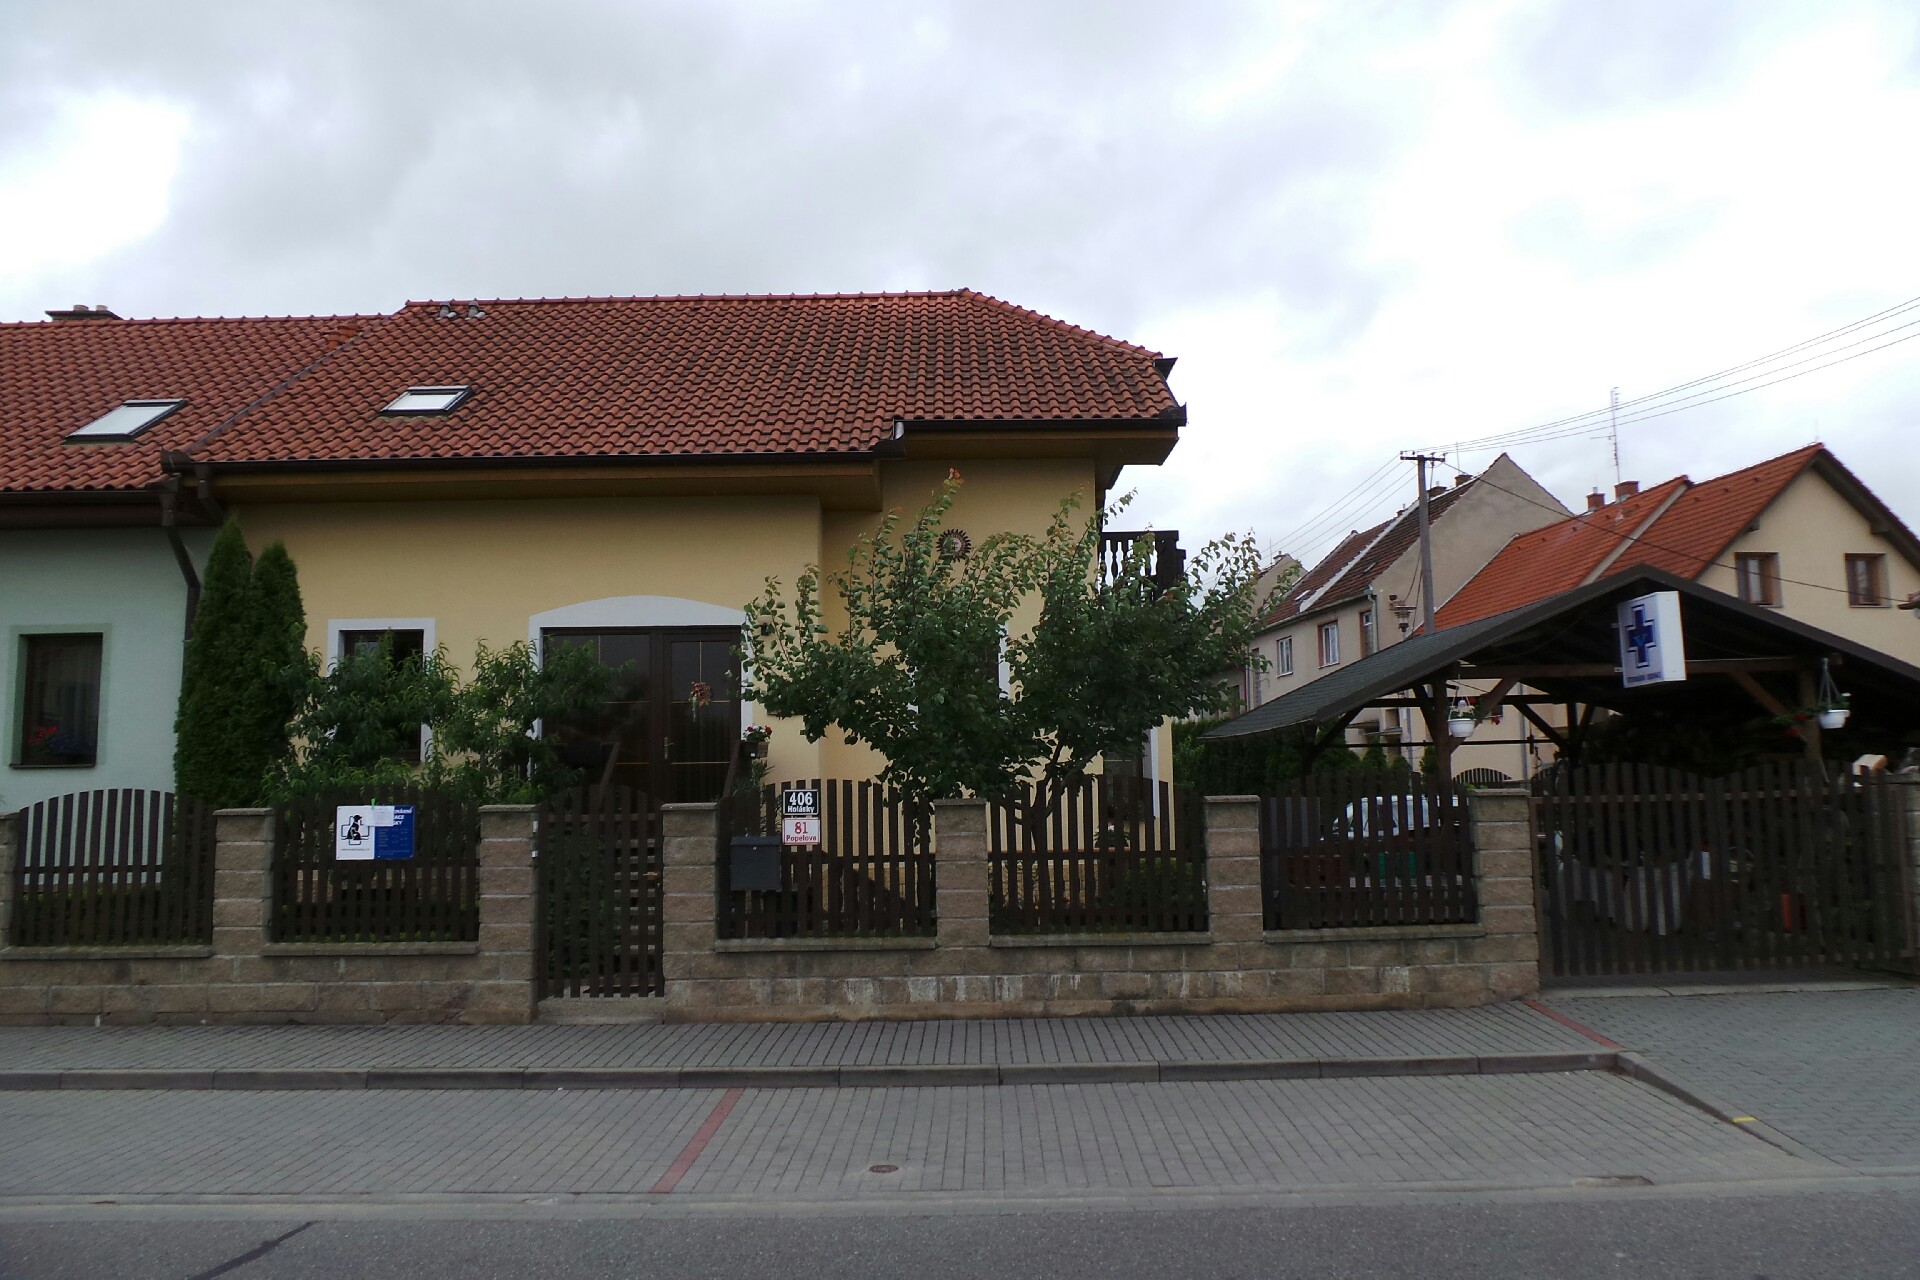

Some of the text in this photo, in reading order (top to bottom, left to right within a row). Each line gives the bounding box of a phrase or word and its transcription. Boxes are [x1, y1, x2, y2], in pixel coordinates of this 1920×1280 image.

[789, 791, 813, 806] 406
[787, 805, 815, 813] Holásky
[794, 821, 808, 834] 81
